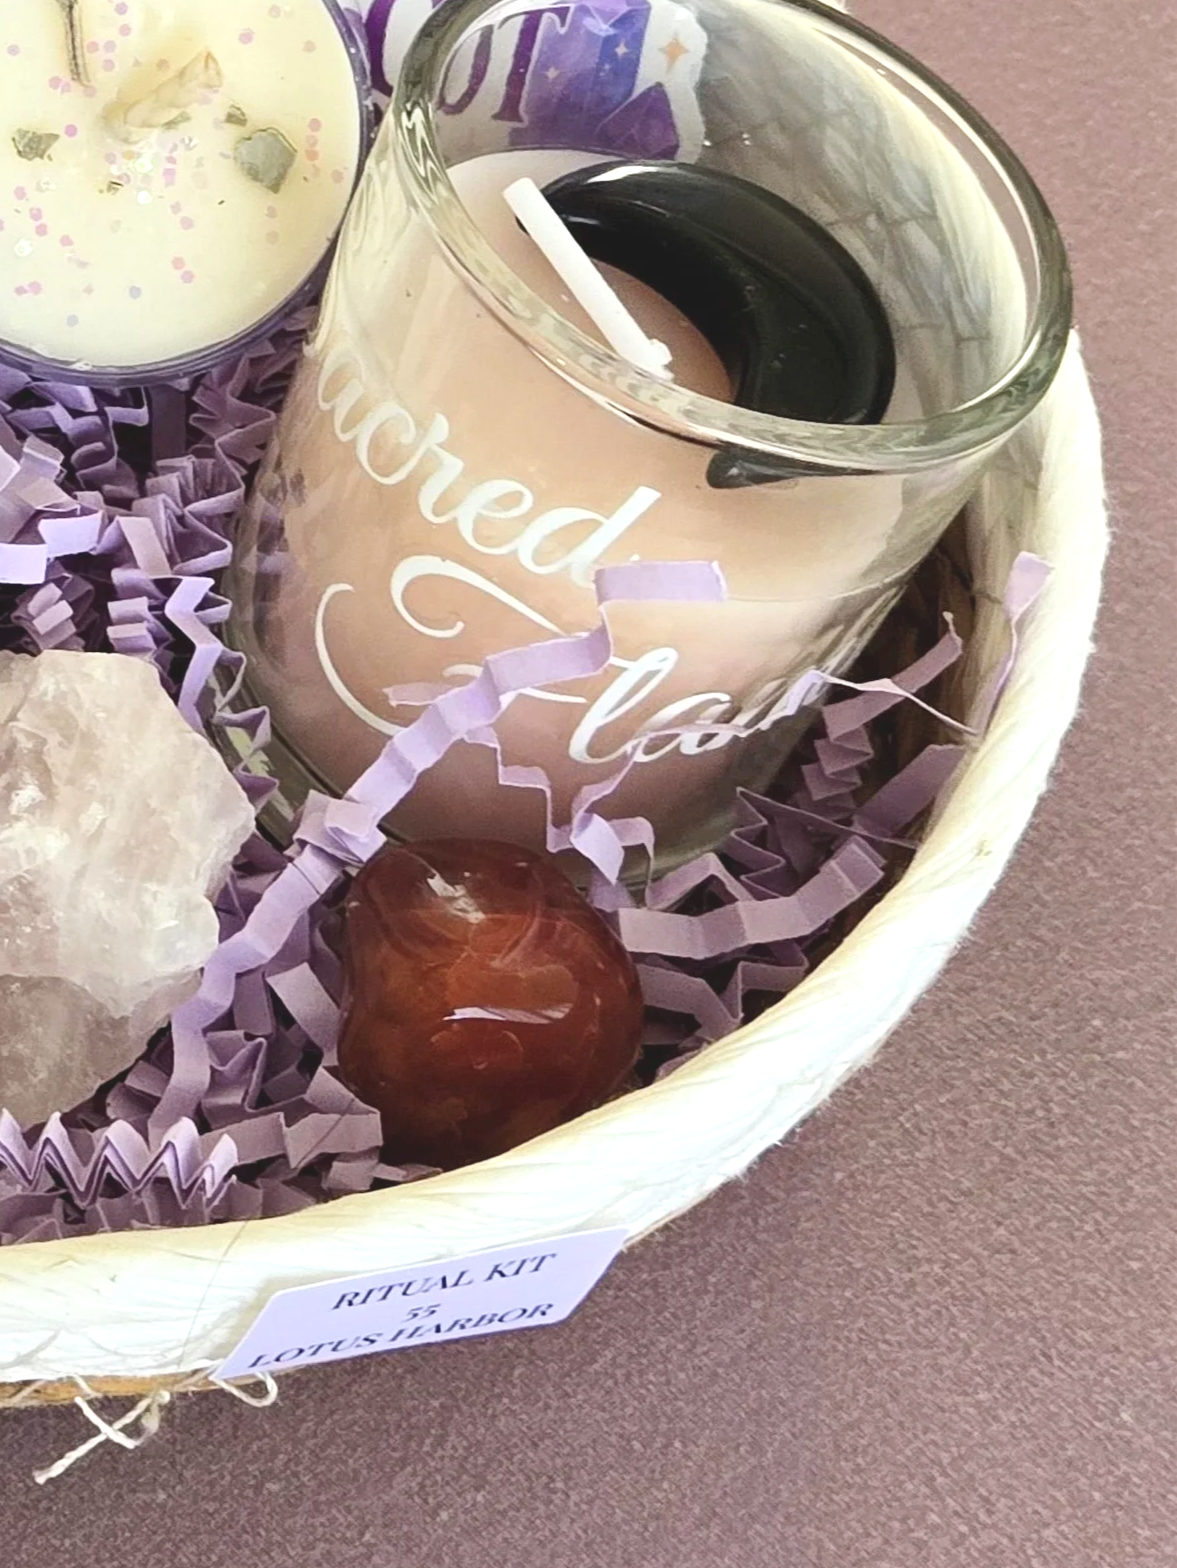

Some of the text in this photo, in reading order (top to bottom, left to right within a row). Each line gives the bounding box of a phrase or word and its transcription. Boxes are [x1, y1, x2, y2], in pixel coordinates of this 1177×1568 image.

[331, 1252, 559, 1311] RITUAL KIT
[247, 1302, 555, 1369] LOTUS HARBOR
[401, 1302, 442, 1323] 55
